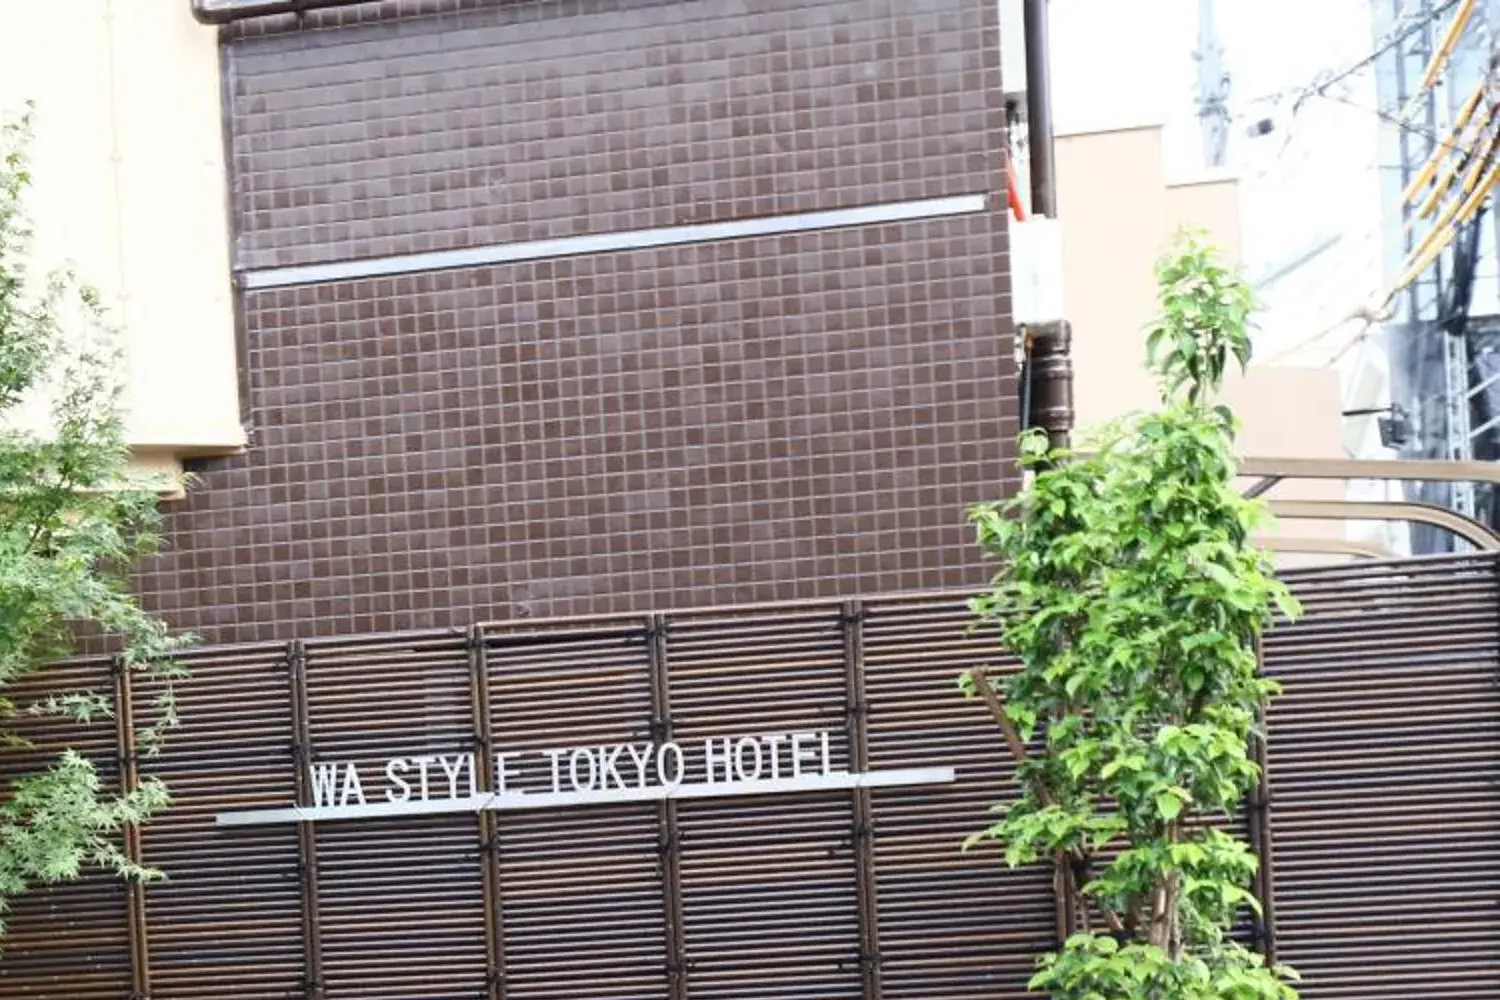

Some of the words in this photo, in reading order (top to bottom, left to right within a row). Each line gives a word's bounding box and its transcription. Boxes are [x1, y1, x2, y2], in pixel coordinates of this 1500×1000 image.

[310, 763, 367, 808] WA
[385, 751, 526, 803] STYLE
[542, 742, 685, 793] TOKYO
[705, 731, 849, 784] HOTEL
